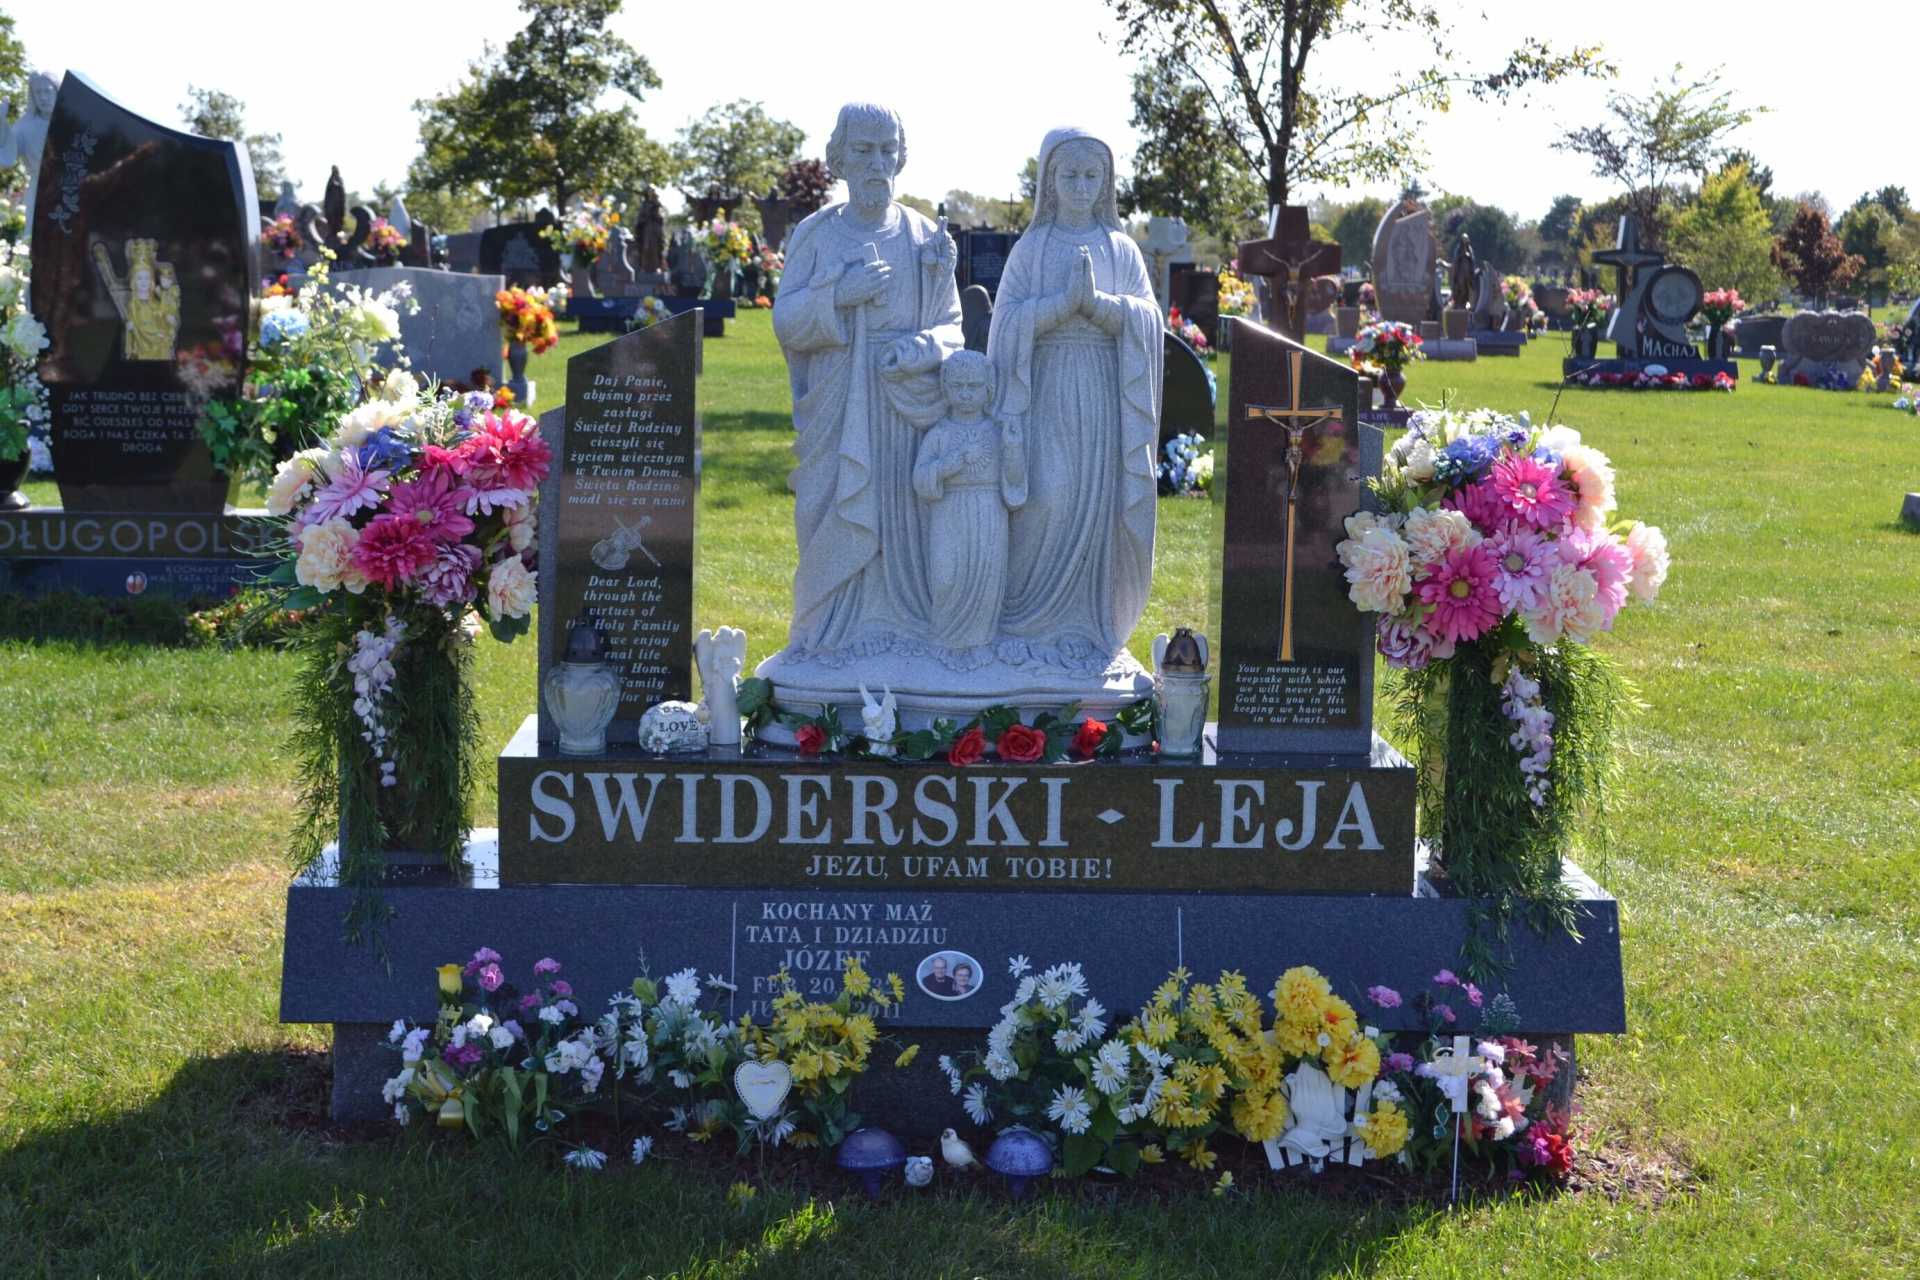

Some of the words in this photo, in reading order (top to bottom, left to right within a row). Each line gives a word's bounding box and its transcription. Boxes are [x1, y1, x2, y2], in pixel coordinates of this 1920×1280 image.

[1642, 335, 1696, 358] MACHAJ
[594, 374, 618, 388] Daj
[625, 375, 668, 389] Panie,
[93, 392, 136, 401] TRUDNO
[583, 389, 633, 403] abyśmy
[638, 391, 672, 403] przez
[124, 404, 161, 415] TWOJE
[603, 407, 653, 420] zasługi
[573, 417, 622, 433] Świętej
[627, 421, 682, 435] Rodziny
[64, 430, 96, 439] BOGA
[122, 443, 162, 453] DROGA
[590, 436, 640, 449] cieszyli
[646, 438, 665, 450] się
[571, 452, 615, 463] życiem
[622, 453, 685, 465] wiecznym
[576, 467, 585, 476] w
[592, 466, 635, 477] Twoim
[642, 466, 683, 478] Domu.
[568, 494, 601, 505] módl
[588, 576, 621, 588] Dear
[627, 576, 663, 590] Lord,
[583, 591, 636, 604] through
[641, 591, 662, 602] the
[589, 606, 635, 616] virtues
[641, 606, 656, 617] of
[594, 619, 626, 633] Holy
[632, 619, 681, 633] Family
[610, 635, 630, 645] we
[633, 634, 670, 647] enjoy
[604, 648, 633, 660] rnal
[638, 648, 661, 660] life
[631, 662, 672, 674] Home.
[1238, 664, 1260, 674] Your
[1267, 666, 1307, 675] memory
[1235, 674, 1282, 685] keepsake
[1288, 675, 1312, 684] with
[1317, 675, 1347, 685] which
[1239, 685, 1253, 693] we
[1259, 684, 1280, 693] will
[1285, 686, 1314, 694] never
[1235, 694, 1256, 704] God
[1262, 694, 1280, 704] has
[1286, 696, 1304, 706] you
[1311, 696, 1321, 704] in
[1327, 695, 1345, 704] His
[1233, 704, 1274, 715] keeping
[1280, 706, 1293, 714] we
[1299, 704, 1323, 715] have
[1328, 707, 1347, 717] you
[1253, 714, 1264, 723] in
[1270, 716, 1288, 724] our
[659, 720, 699, 733] LOVE
[530, 770, 1071, 849] SWIDERSKI
[1151, 778, 1384, 852] LEJA
[805, 855, 888, 881] JEZU,
[904, 856, 988, 879] UFAM
[1006, 856, 1112, 880] TOBIE!
[763, 902, 875, 921] KOCHANY
[885, 900, 933, 925] MĄŻ
[745, 925, 803, 944] TATA
[814, 926, 821, 944] I
[835, 926, 948, 946] DZIADZIU
